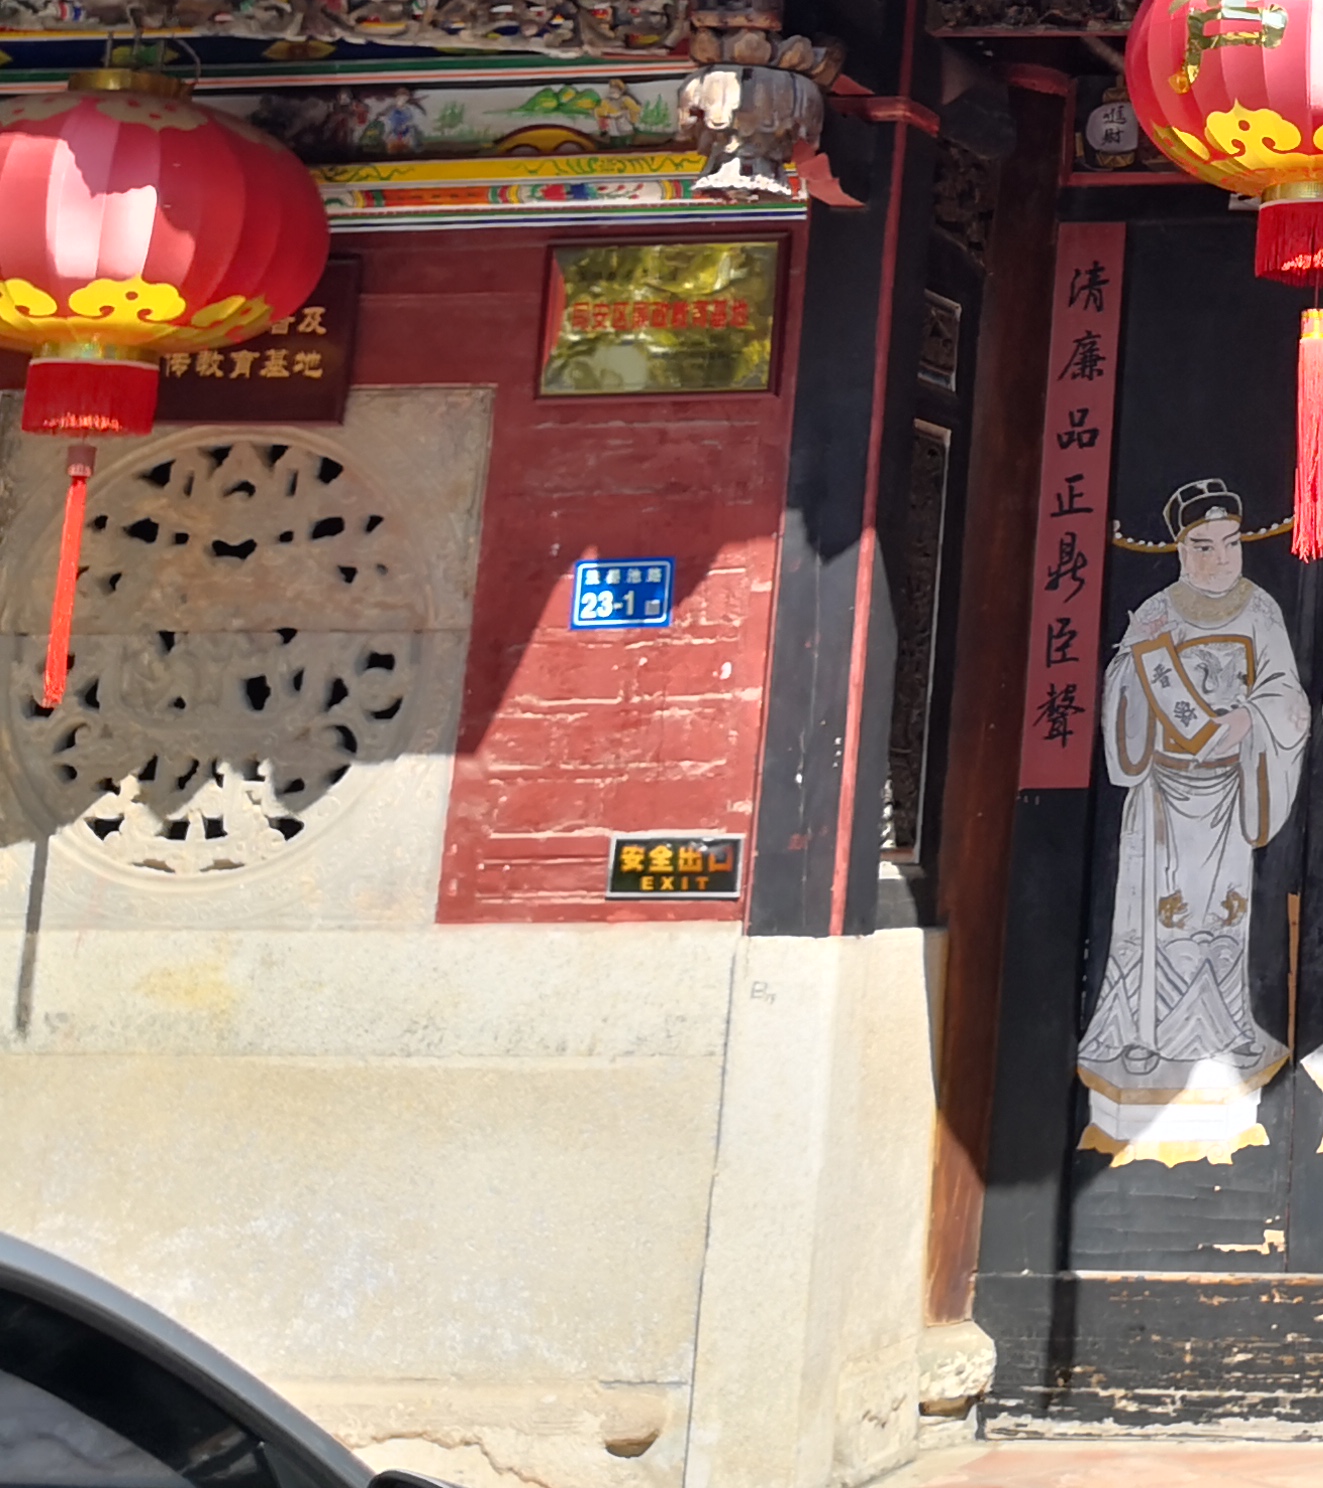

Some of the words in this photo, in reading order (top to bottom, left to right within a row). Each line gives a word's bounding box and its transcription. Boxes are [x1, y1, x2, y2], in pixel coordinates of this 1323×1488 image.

[580, 590, 634, 619] 23-1
[621, 845, 733, 872] 安全出口
[641, 876, 709, 891] EXIT
